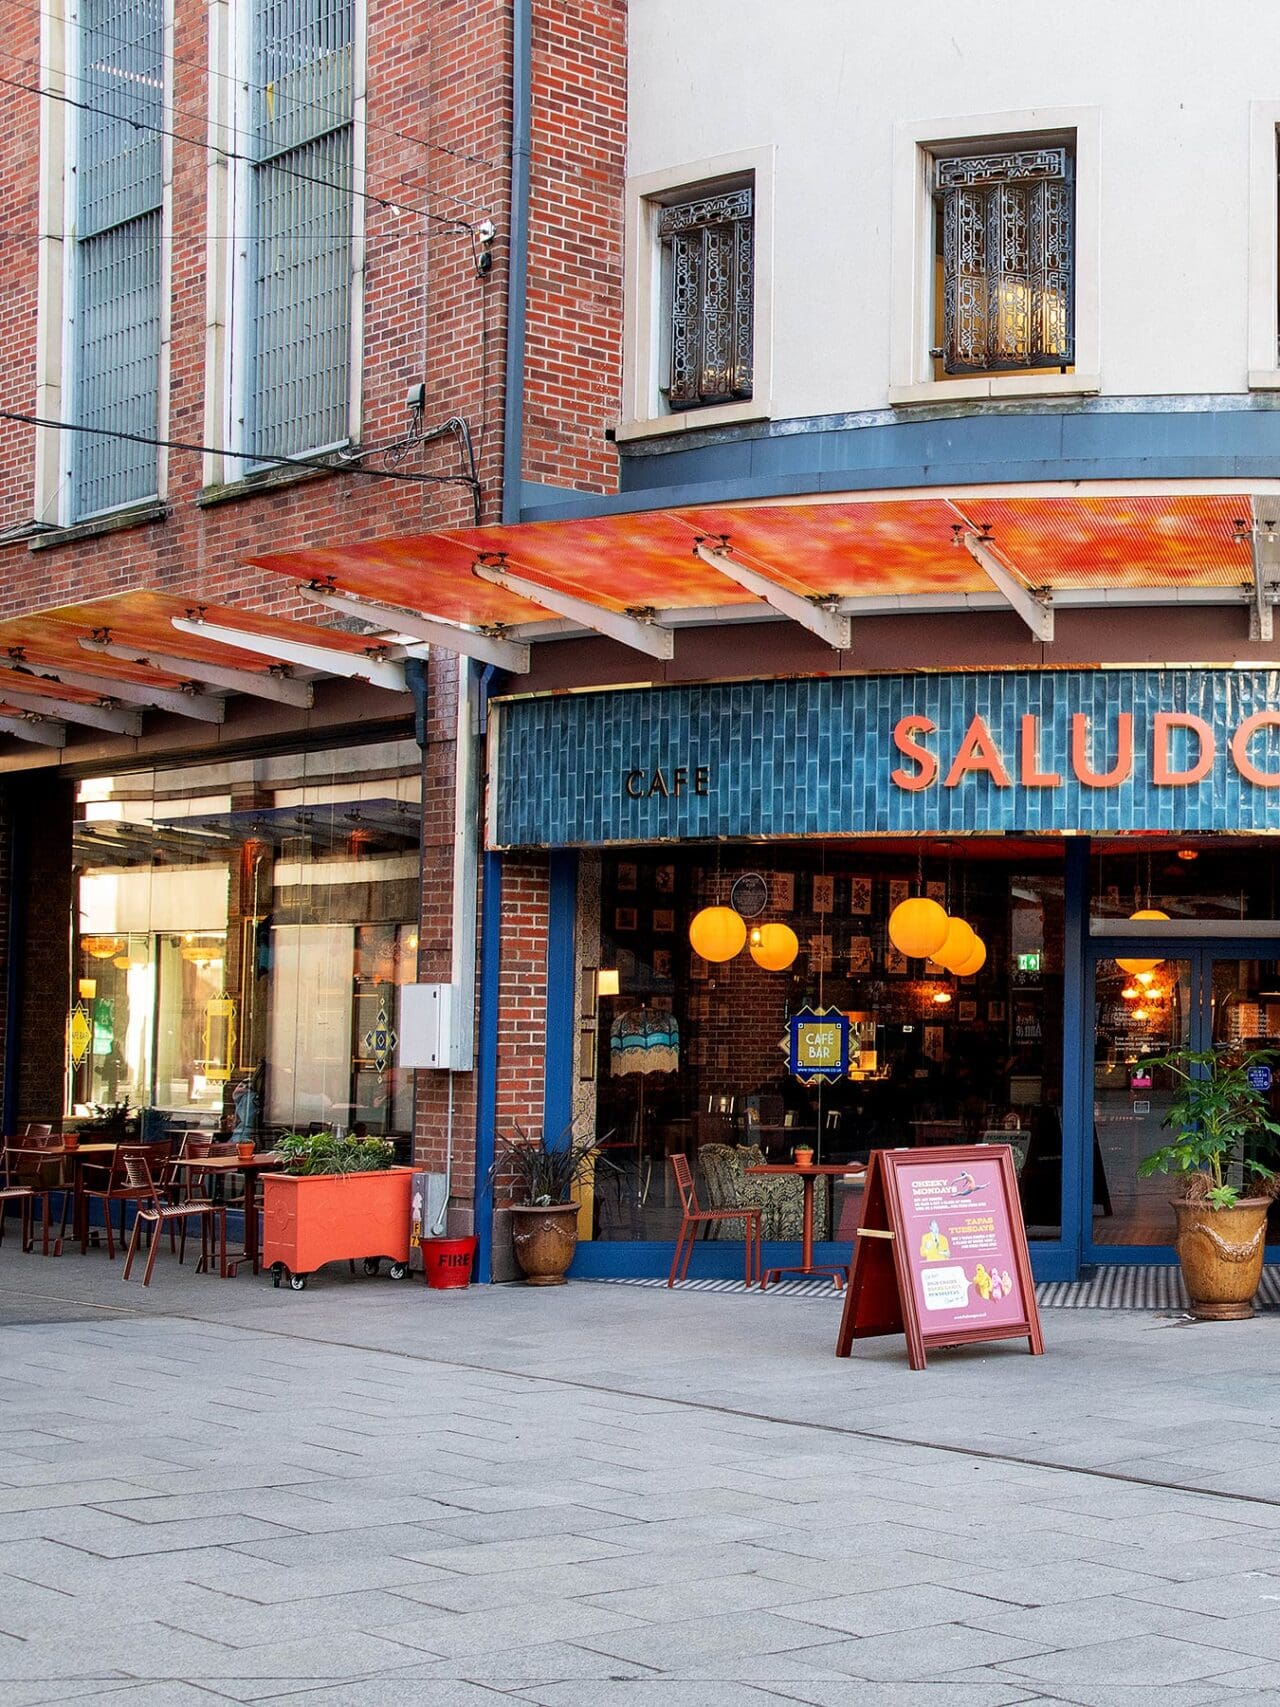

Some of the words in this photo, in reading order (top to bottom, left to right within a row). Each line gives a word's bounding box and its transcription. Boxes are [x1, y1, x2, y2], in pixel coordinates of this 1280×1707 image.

[626, 767, 711, 799] CAFE
[805, 1031, 834, 1045] CAFÉ
[809, 1046, 830, 1058] BAR
[911, 1180, 948, 1188] CHEEKY
[912, 1186, 958, 1195] MONDAYS
[965, 1217, 993, 1226] TAPAS
[949, 1224, 995, 1234] TUESDAYS
[438, 1253, 470, 1267] FIRE
